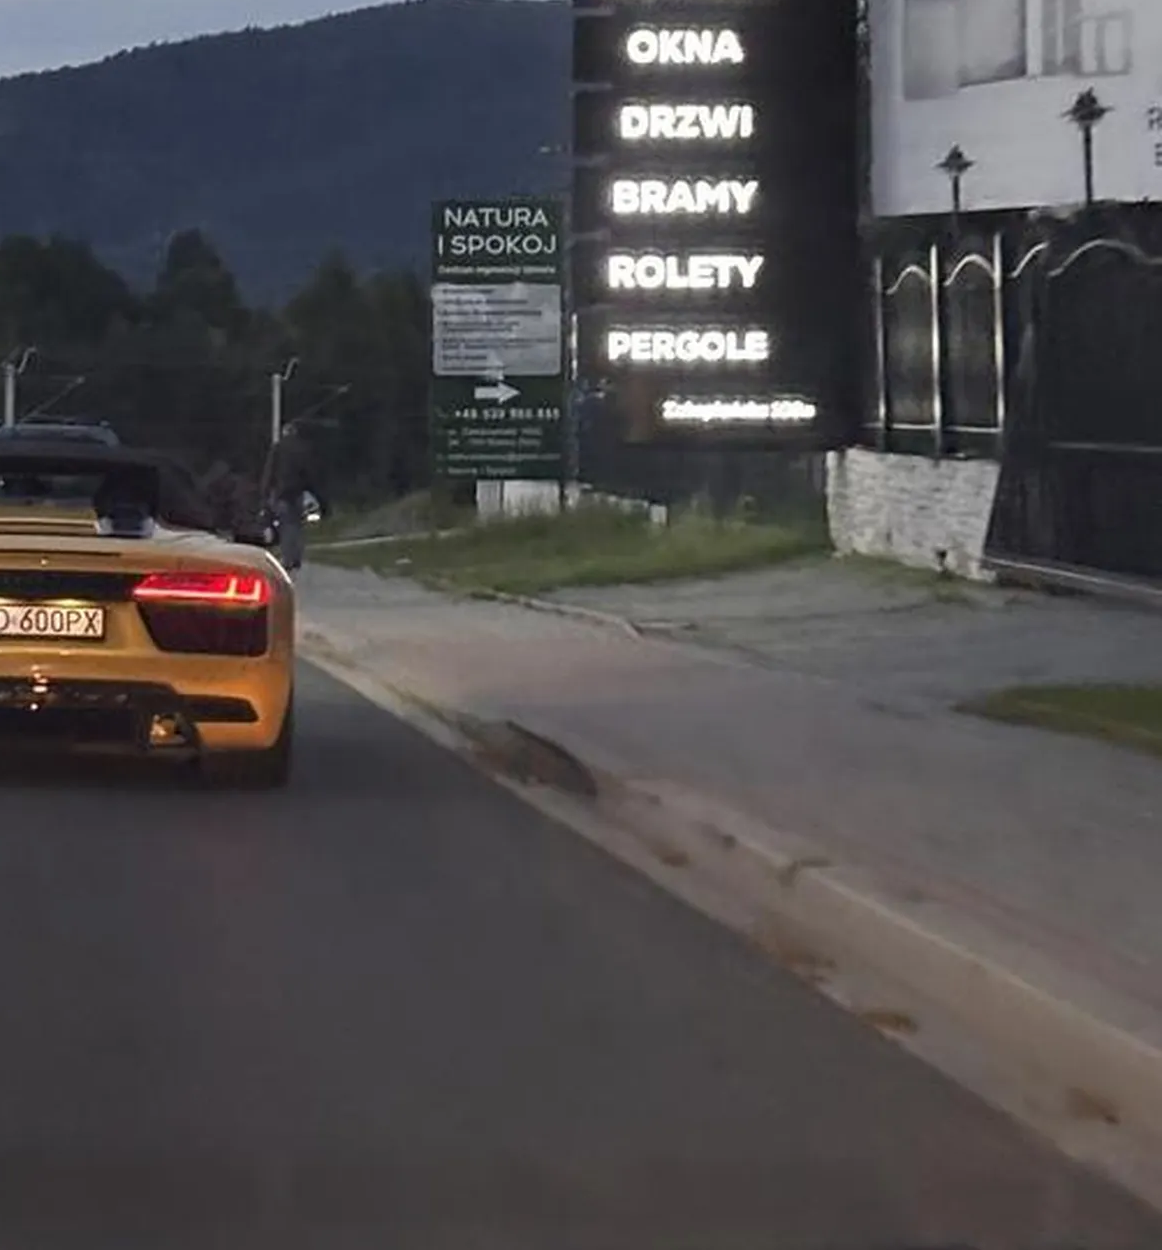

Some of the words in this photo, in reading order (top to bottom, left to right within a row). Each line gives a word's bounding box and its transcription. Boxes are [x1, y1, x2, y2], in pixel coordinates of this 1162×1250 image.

[627, 29, 745, 64] OKNA
[620, 104, 754, 139] DRZWI
[612, 180, 759, 214] BRAMY
[444, 207, 548, 228] NATURA
[607, 255, 764, 289] ROLETY
[607, 331, 769, 361] PERGOLE
[19, 609, 99, 634] 600PX
